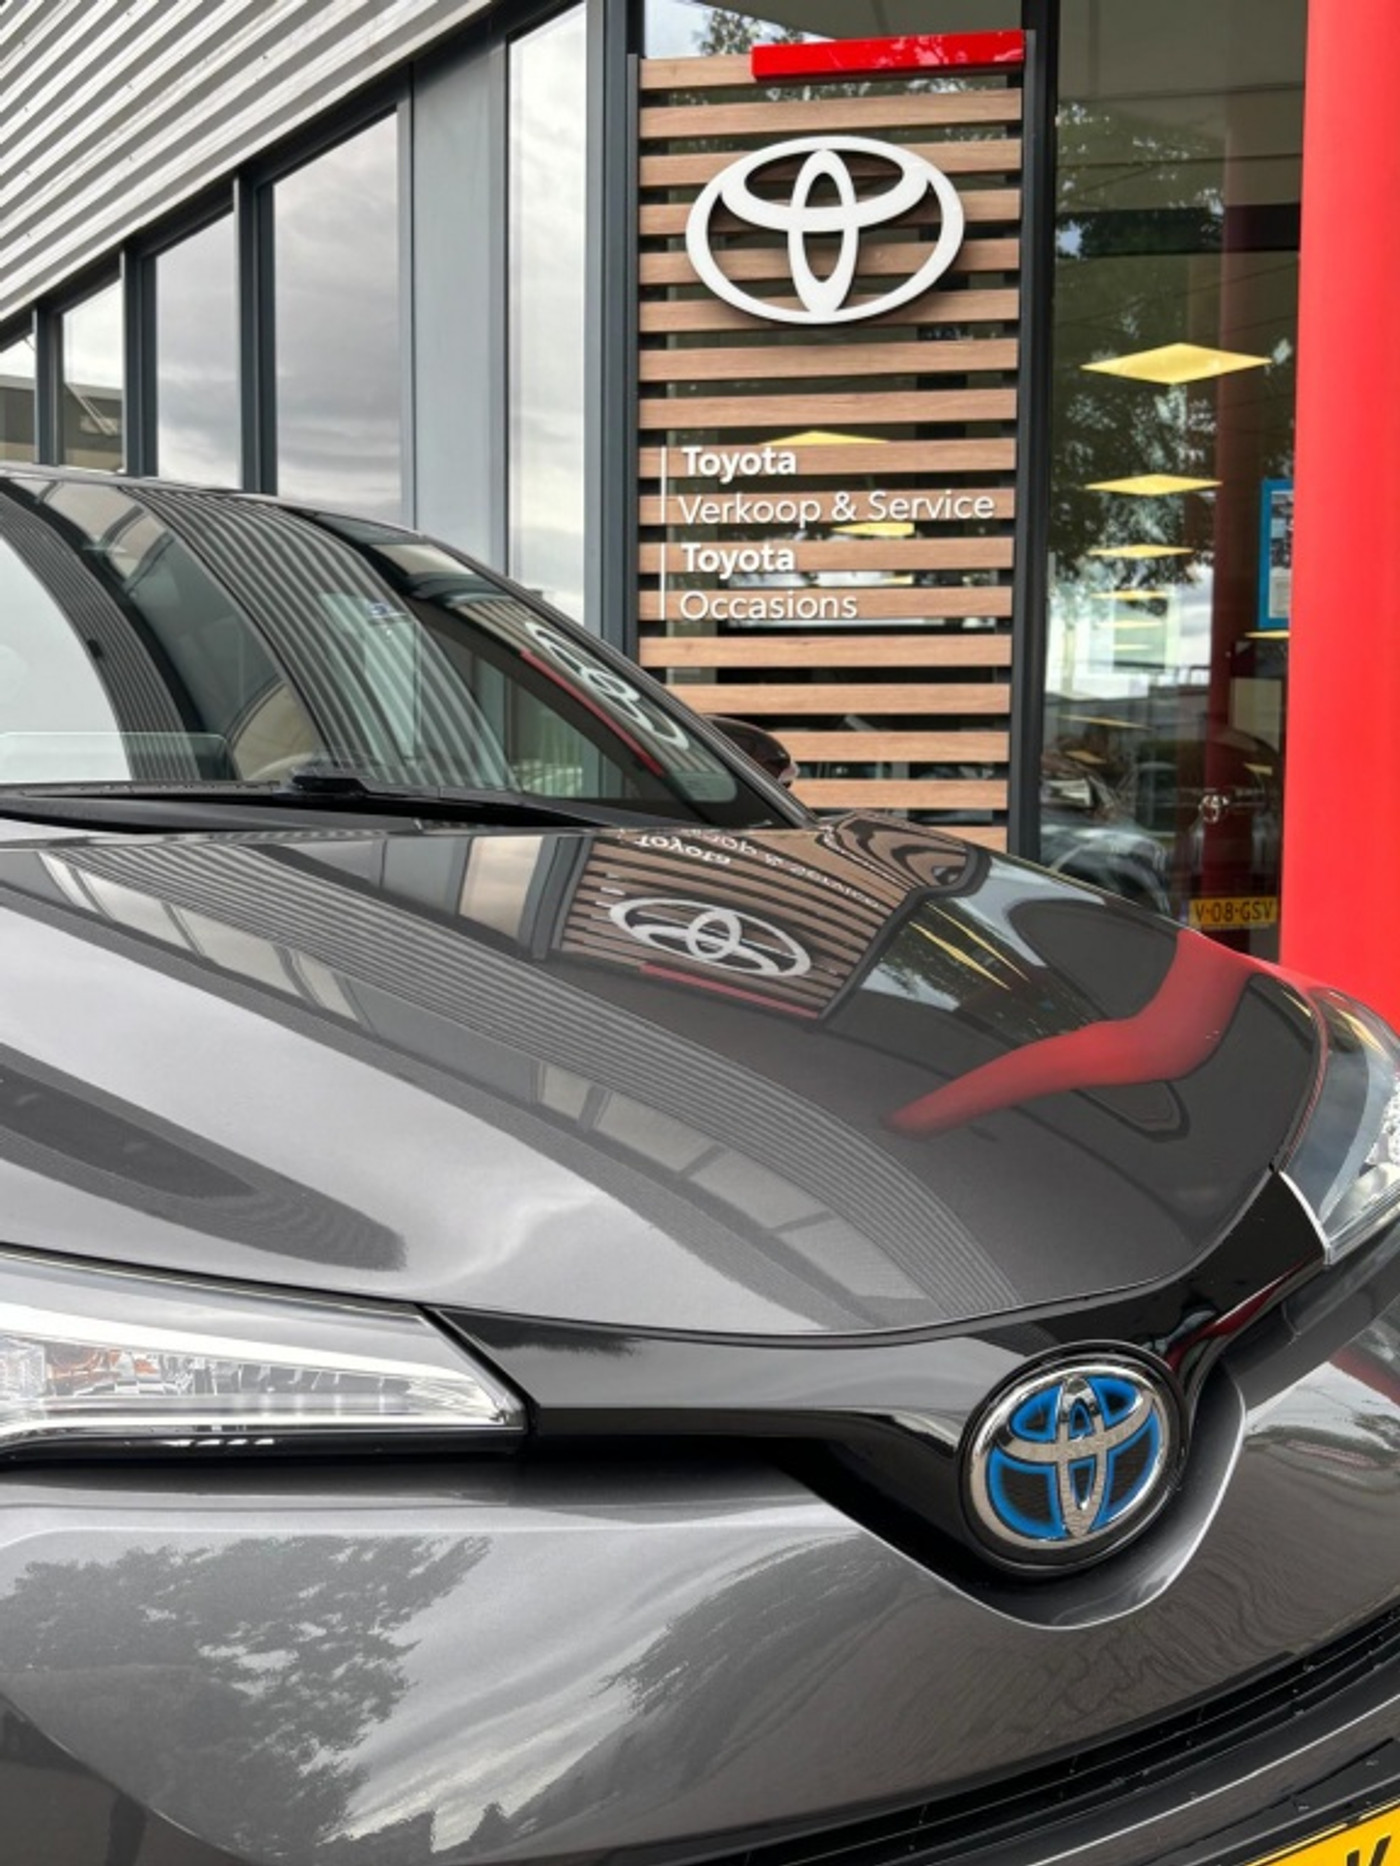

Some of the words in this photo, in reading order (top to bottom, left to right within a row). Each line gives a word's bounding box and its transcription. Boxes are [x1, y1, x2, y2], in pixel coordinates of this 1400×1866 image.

[681, 447, 797, 483] Toyota
[678, 493, 821, 528] Verkoop
[831, 491, 856, 521] &
[868, 489, 995, 519] Service
[681, 543, 795, 579] Toyota
[679, 591, 857, 620] Occasions
